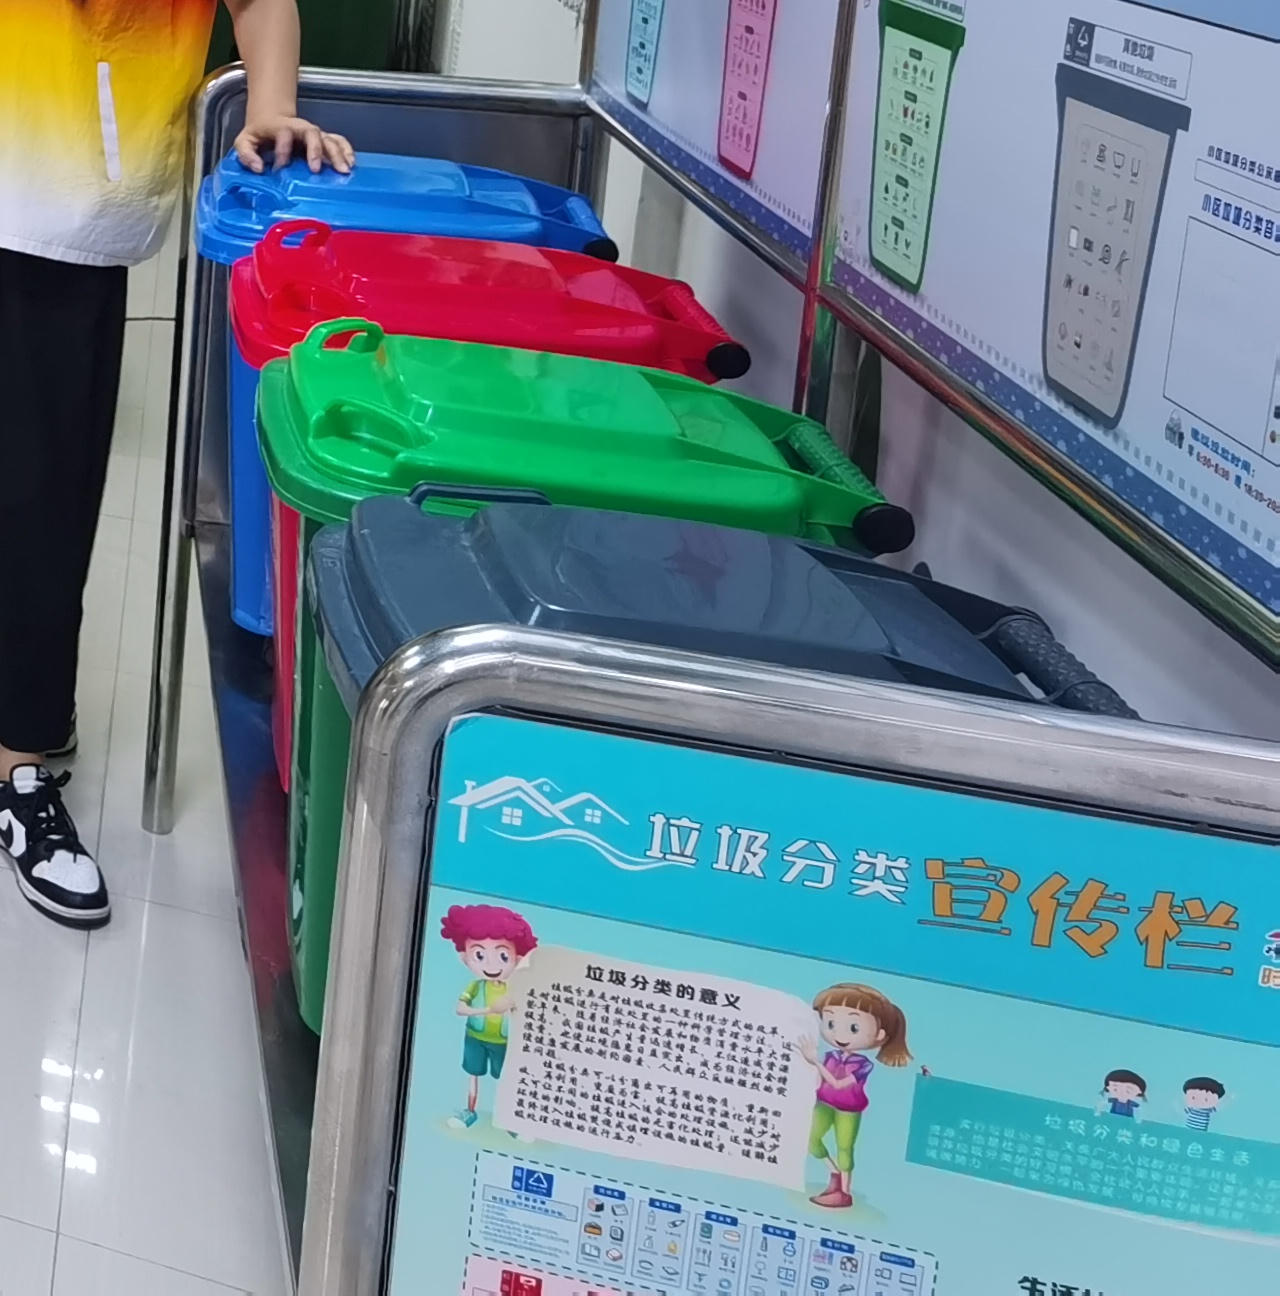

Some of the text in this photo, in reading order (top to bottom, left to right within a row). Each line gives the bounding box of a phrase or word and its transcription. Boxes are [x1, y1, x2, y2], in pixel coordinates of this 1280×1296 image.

[645, 812, 1239, 976] 垃圾分类宣传栏
[584, 963, 743, 1012] 垃圾分类的意义
[1044, 1112, 1252, 1167] 垃圾分类和绿色生活
